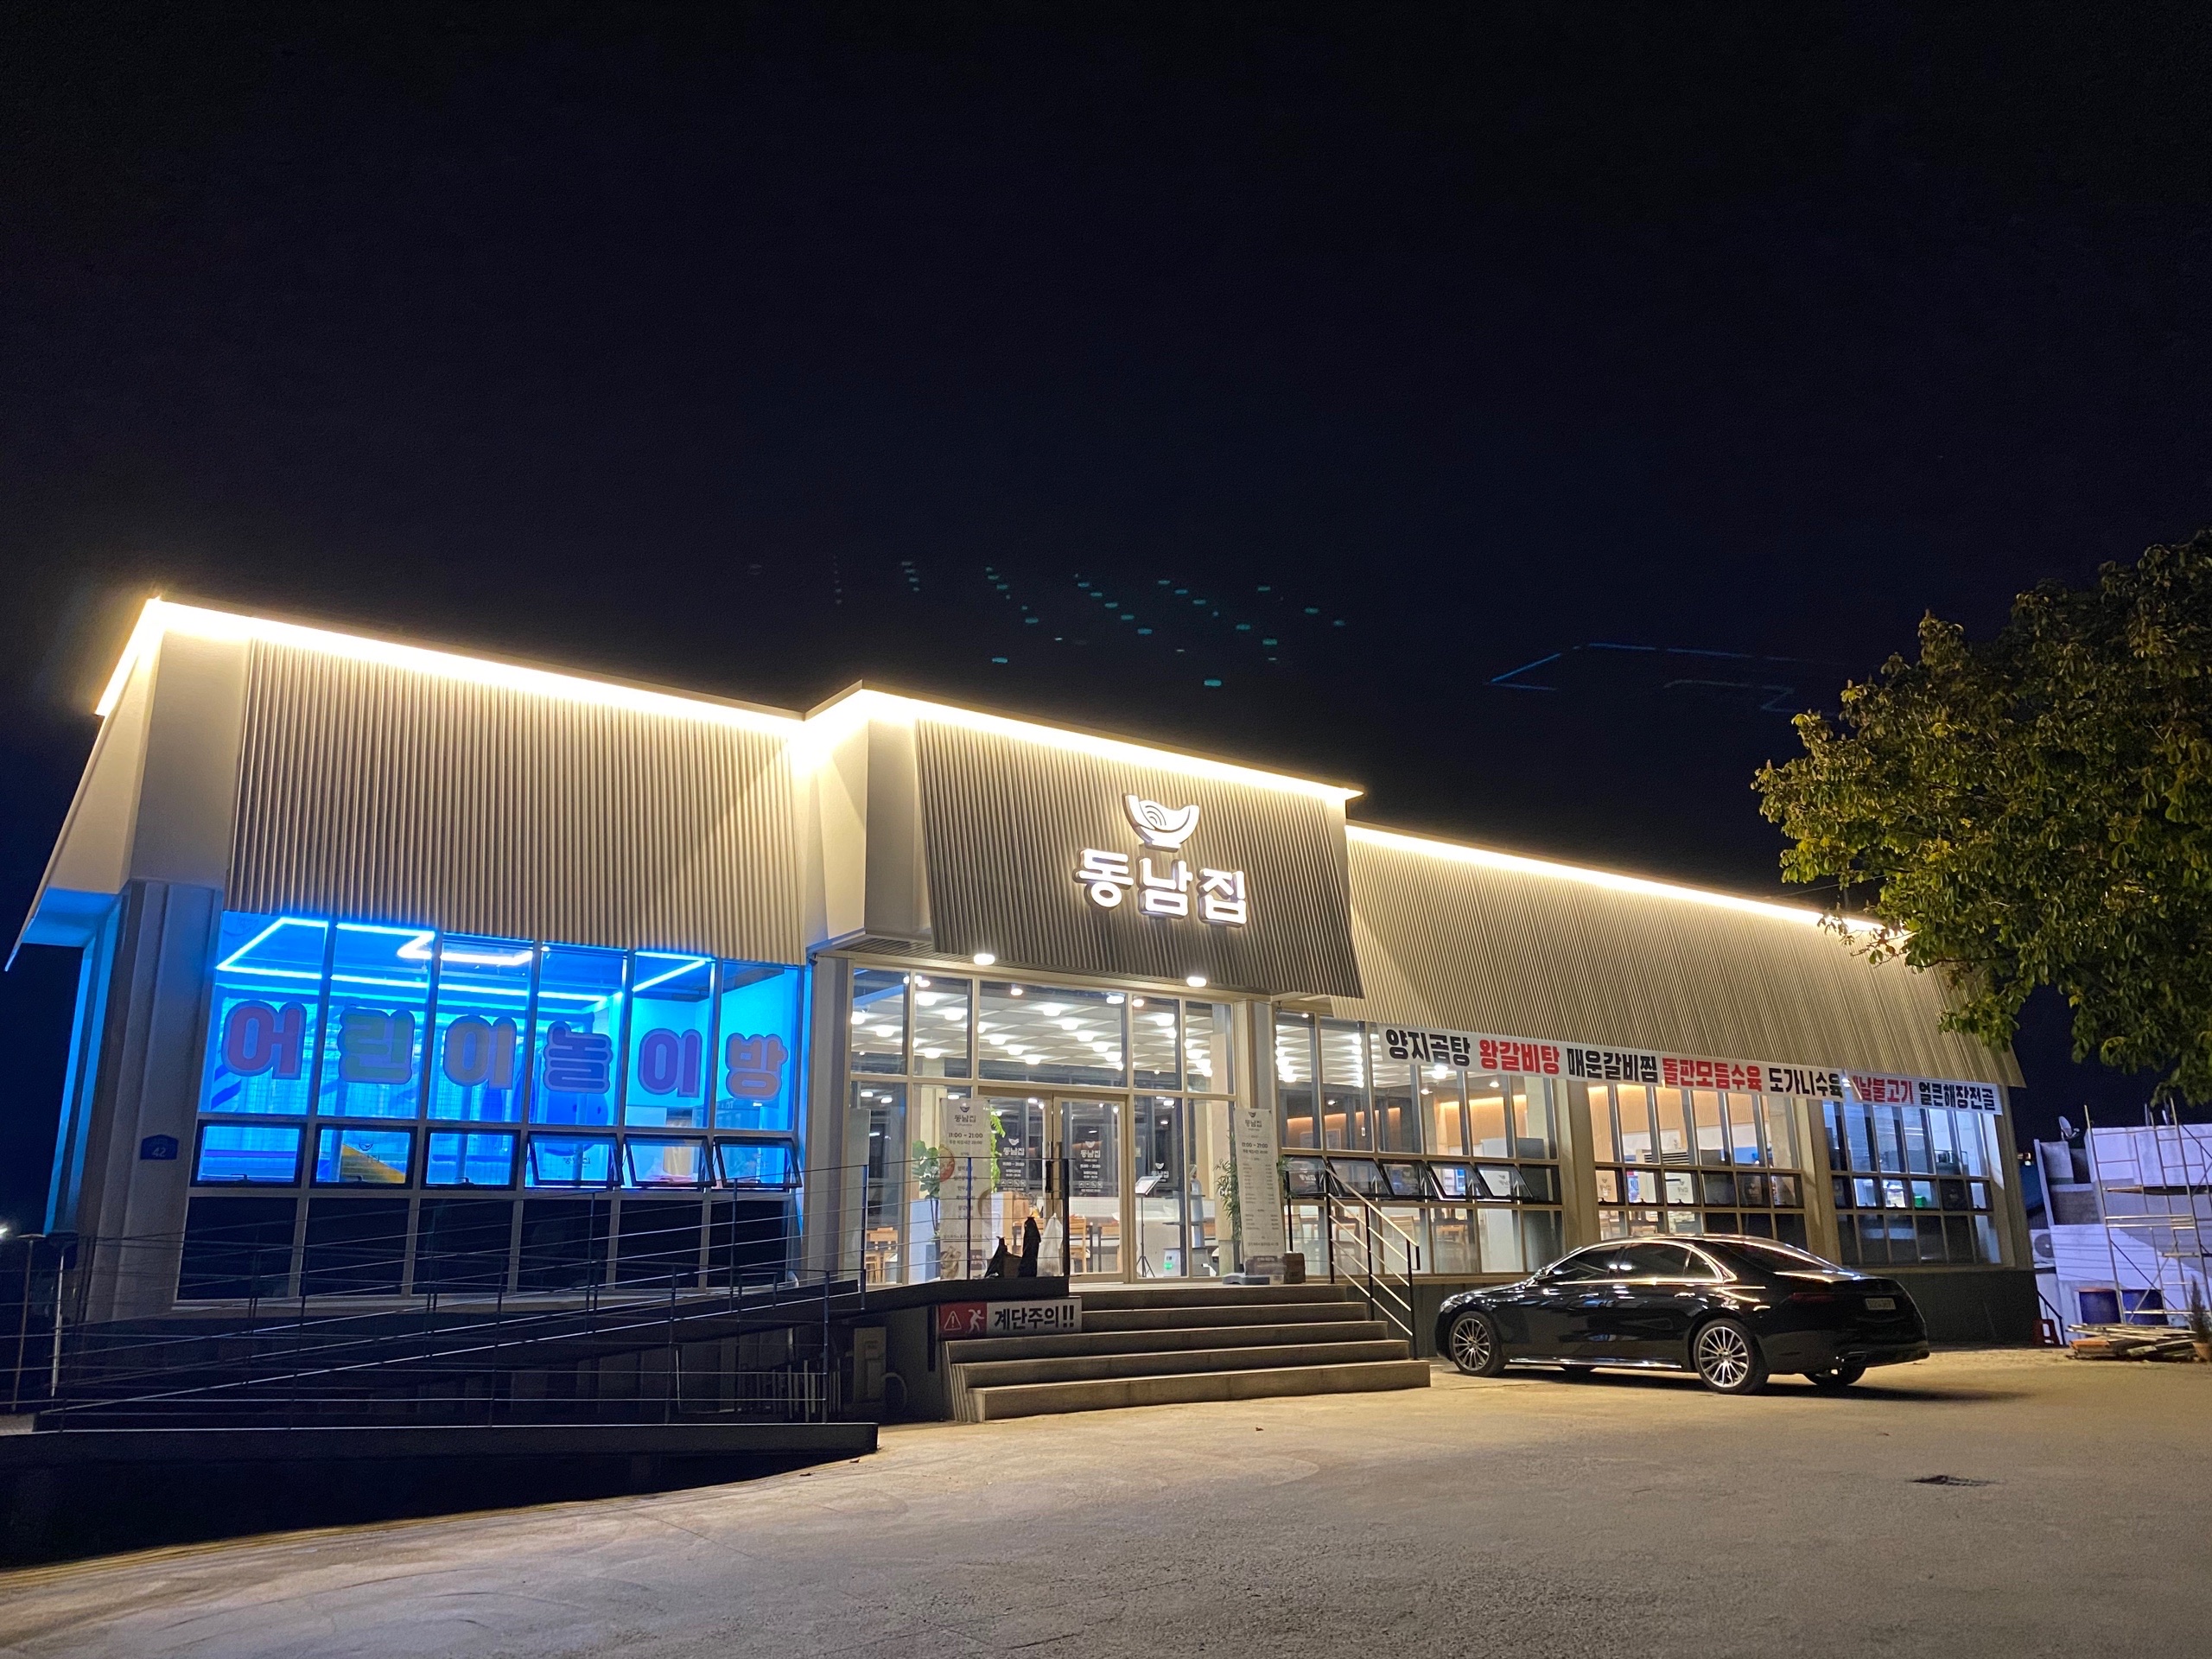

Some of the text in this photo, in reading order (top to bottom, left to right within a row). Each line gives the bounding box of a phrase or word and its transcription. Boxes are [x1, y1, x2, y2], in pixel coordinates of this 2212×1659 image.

[1073, 848, 1248, 926] 동남집
[1385, 1028, 1658, 1084] 양지곰탕 왕갈비탕 매운갈비찜
[1662, 1058, 1844, 1098] 돌판모듬수육 도가니수육
[1852, 1074, 1996, 1111] 날불고기 얼큰해장전골
[994, 1304, 1075, 1331] 계단주의!!
